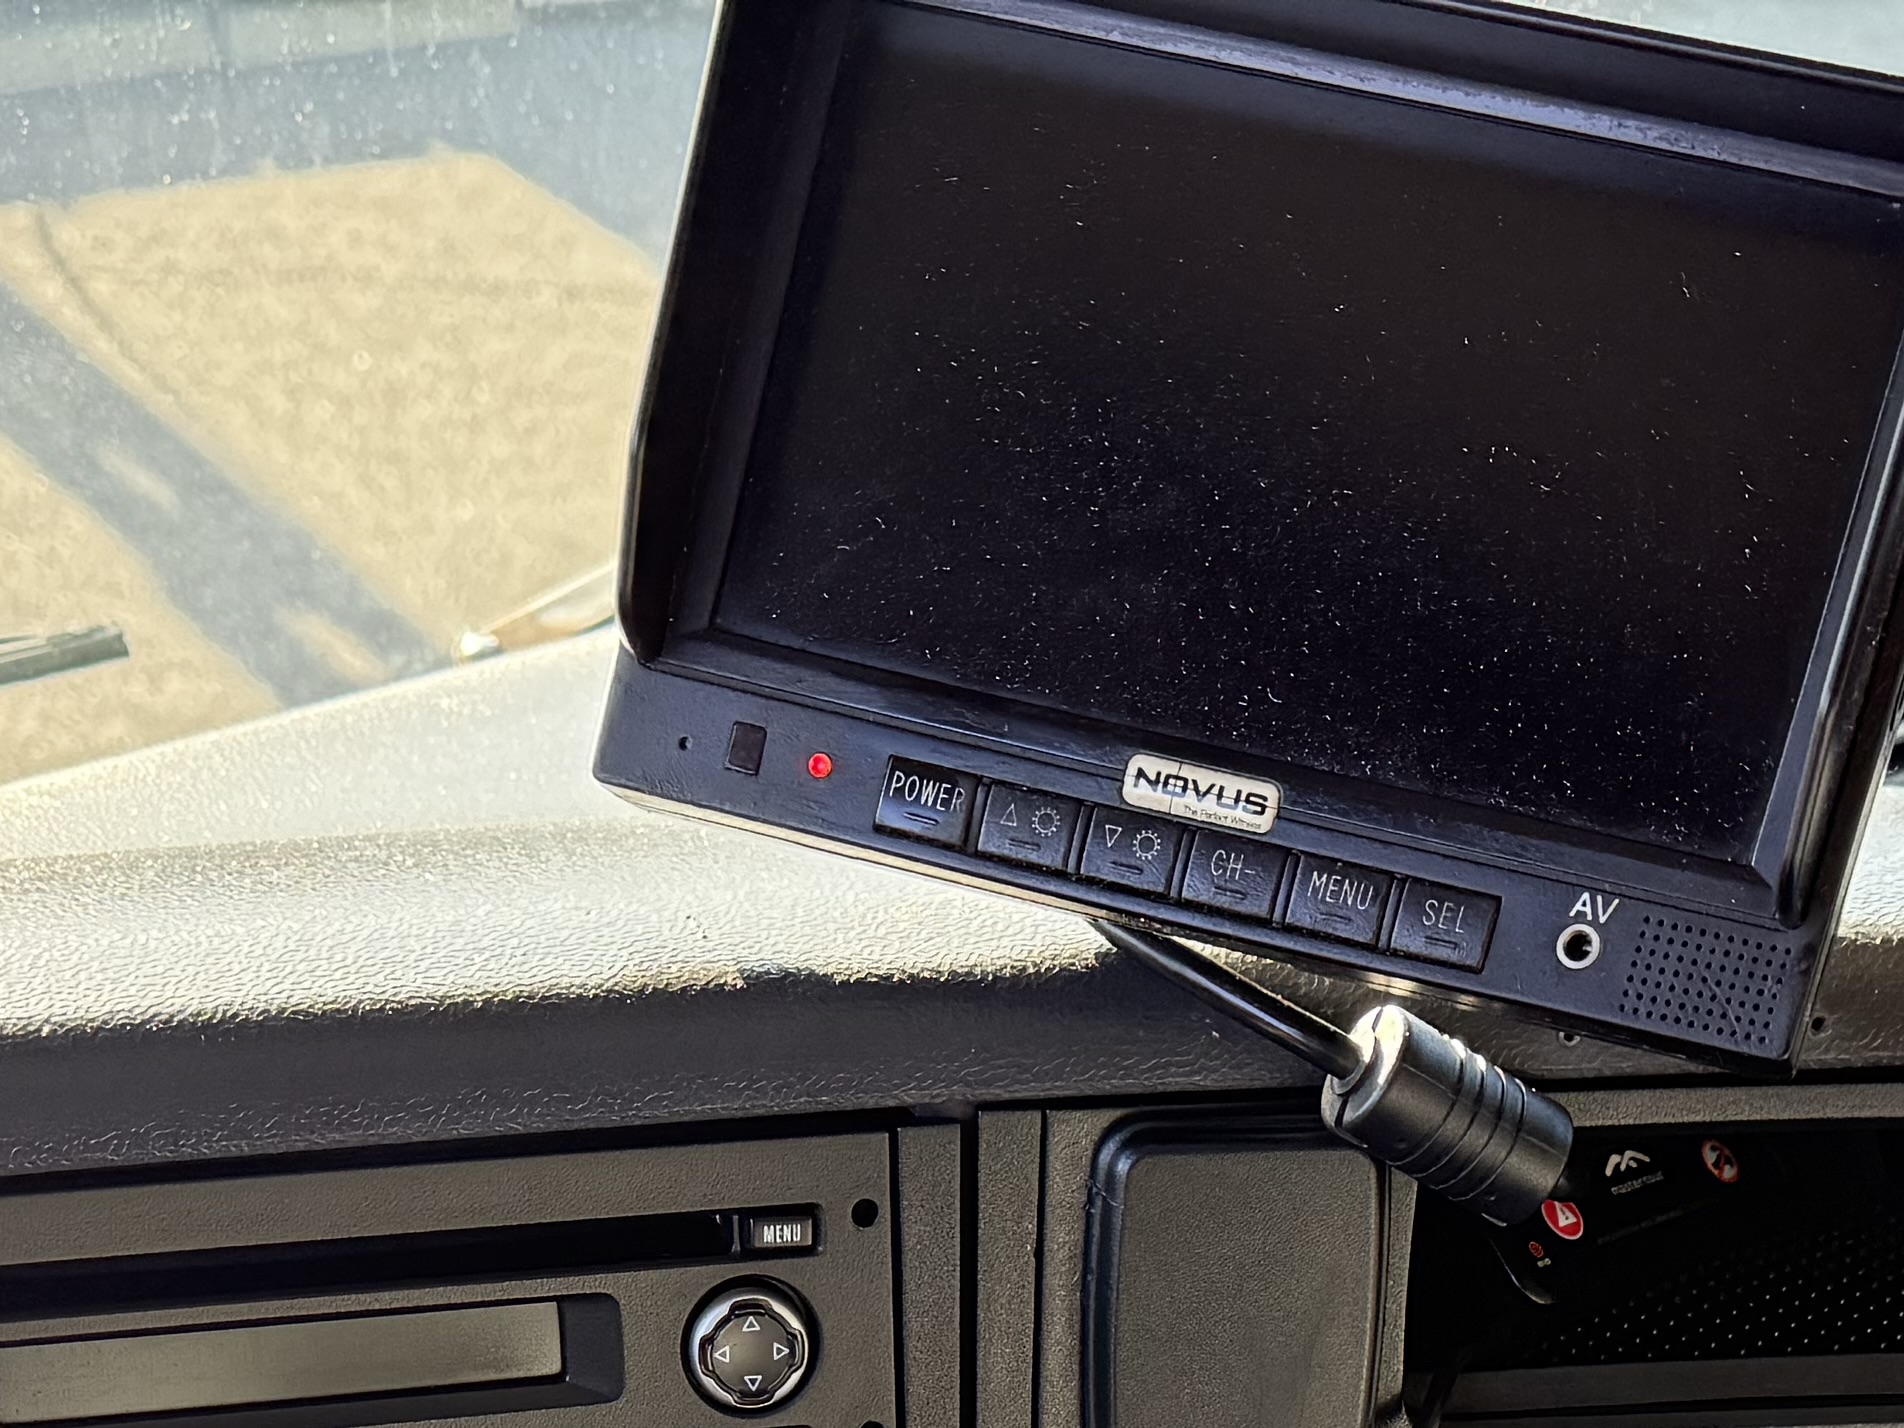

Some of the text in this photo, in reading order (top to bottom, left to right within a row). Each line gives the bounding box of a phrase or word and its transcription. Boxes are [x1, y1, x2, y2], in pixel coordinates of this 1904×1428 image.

[889, 770, 966, 813] POWER
[1133, 766, 1269, 817] NOVUS
[1307, 871, 1376, 911] MENU
[1569, 891, 1620, 925] AV
[1422, 899, 1466, 934] SEL
[762, 1222, 802, 1245] MENU
